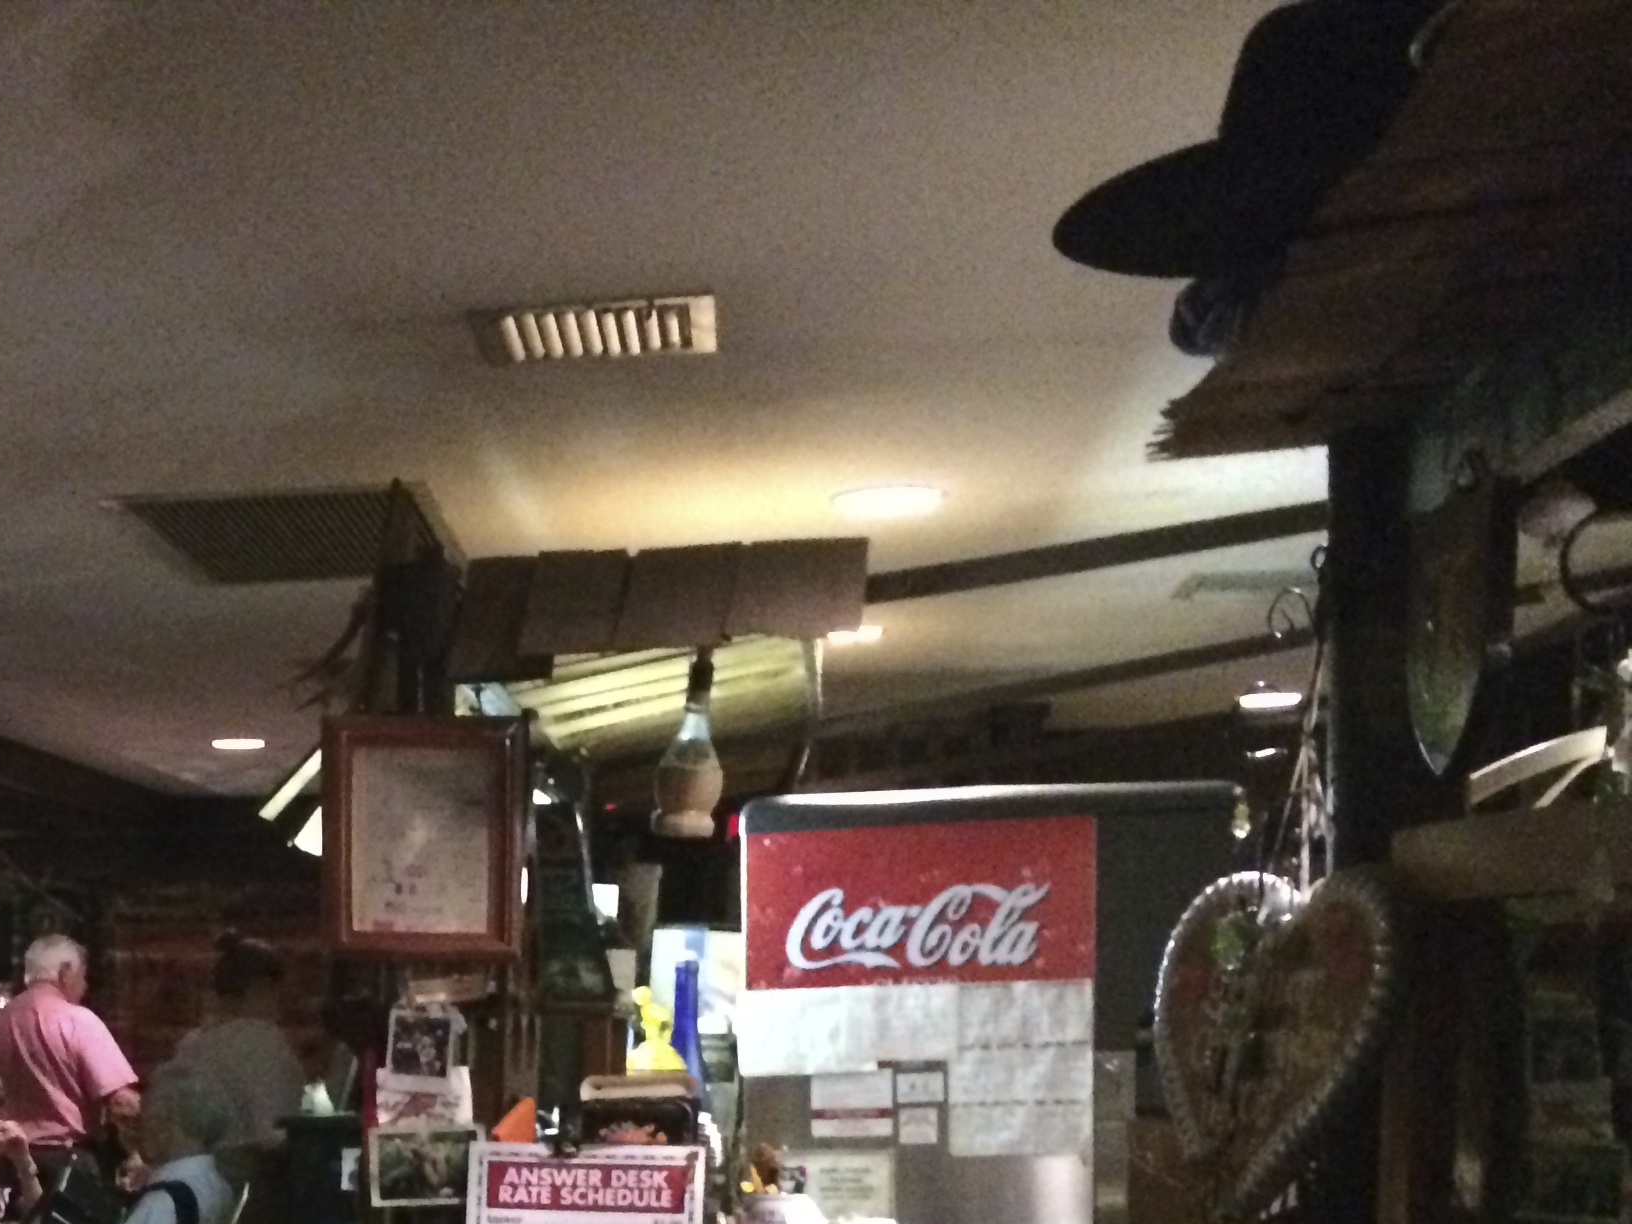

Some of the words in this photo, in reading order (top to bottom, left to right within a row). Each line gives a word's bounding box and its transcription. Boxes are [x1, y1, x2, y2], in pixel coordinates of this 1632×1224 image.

[785, 881, 1052, 971] Coca-Cola
[503, 1166, 602, 1188] ANSWER
[610, 1169, 669, 1188] DESK
[498, 1185, 552, 1205] RATE
[559, 1187, 673, 1208] SCHEDULE
